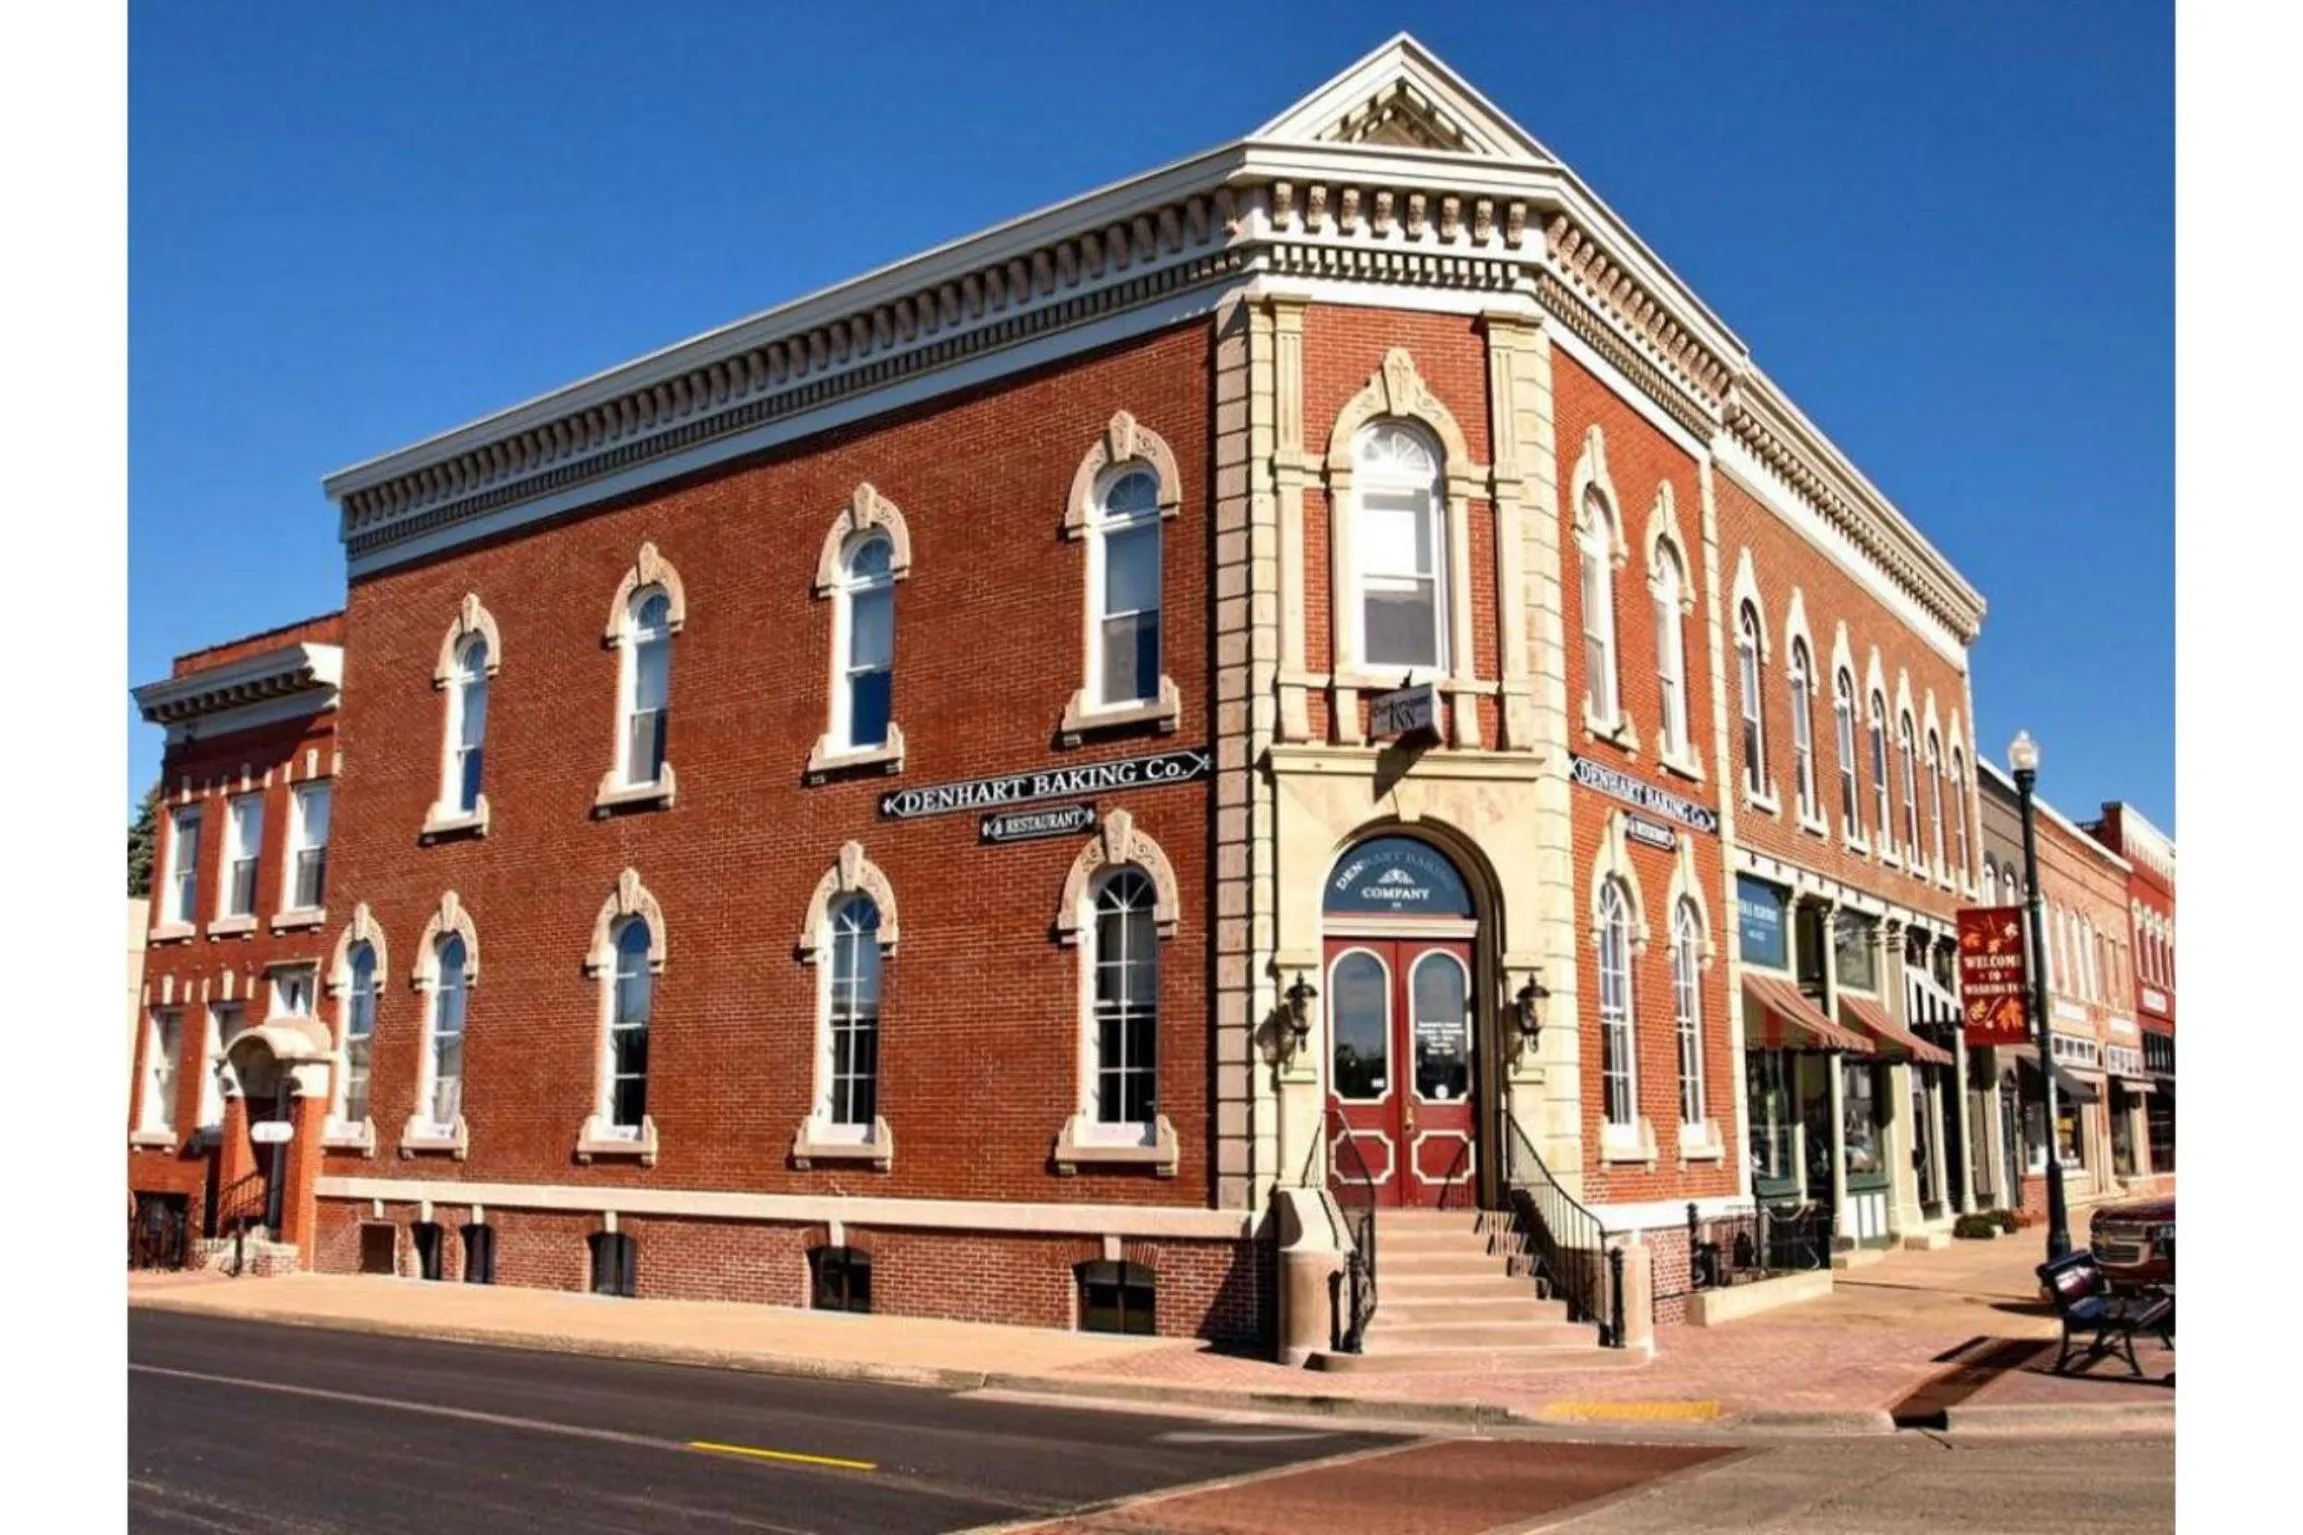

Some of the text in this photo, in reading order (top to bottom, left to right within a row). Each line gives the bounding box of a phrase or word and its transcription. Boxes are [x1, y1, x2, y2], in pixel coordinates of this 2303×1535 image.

[902, 758, 1189, 815] DENHART BAKING Co.
[1005, 811, 1080, 835] RESTAURANT
[1361, 887, 1430, 900] COMPANY
[1964, 954, 2022, 969] WELCOME
[1989, 970, 2002, 981] TO
